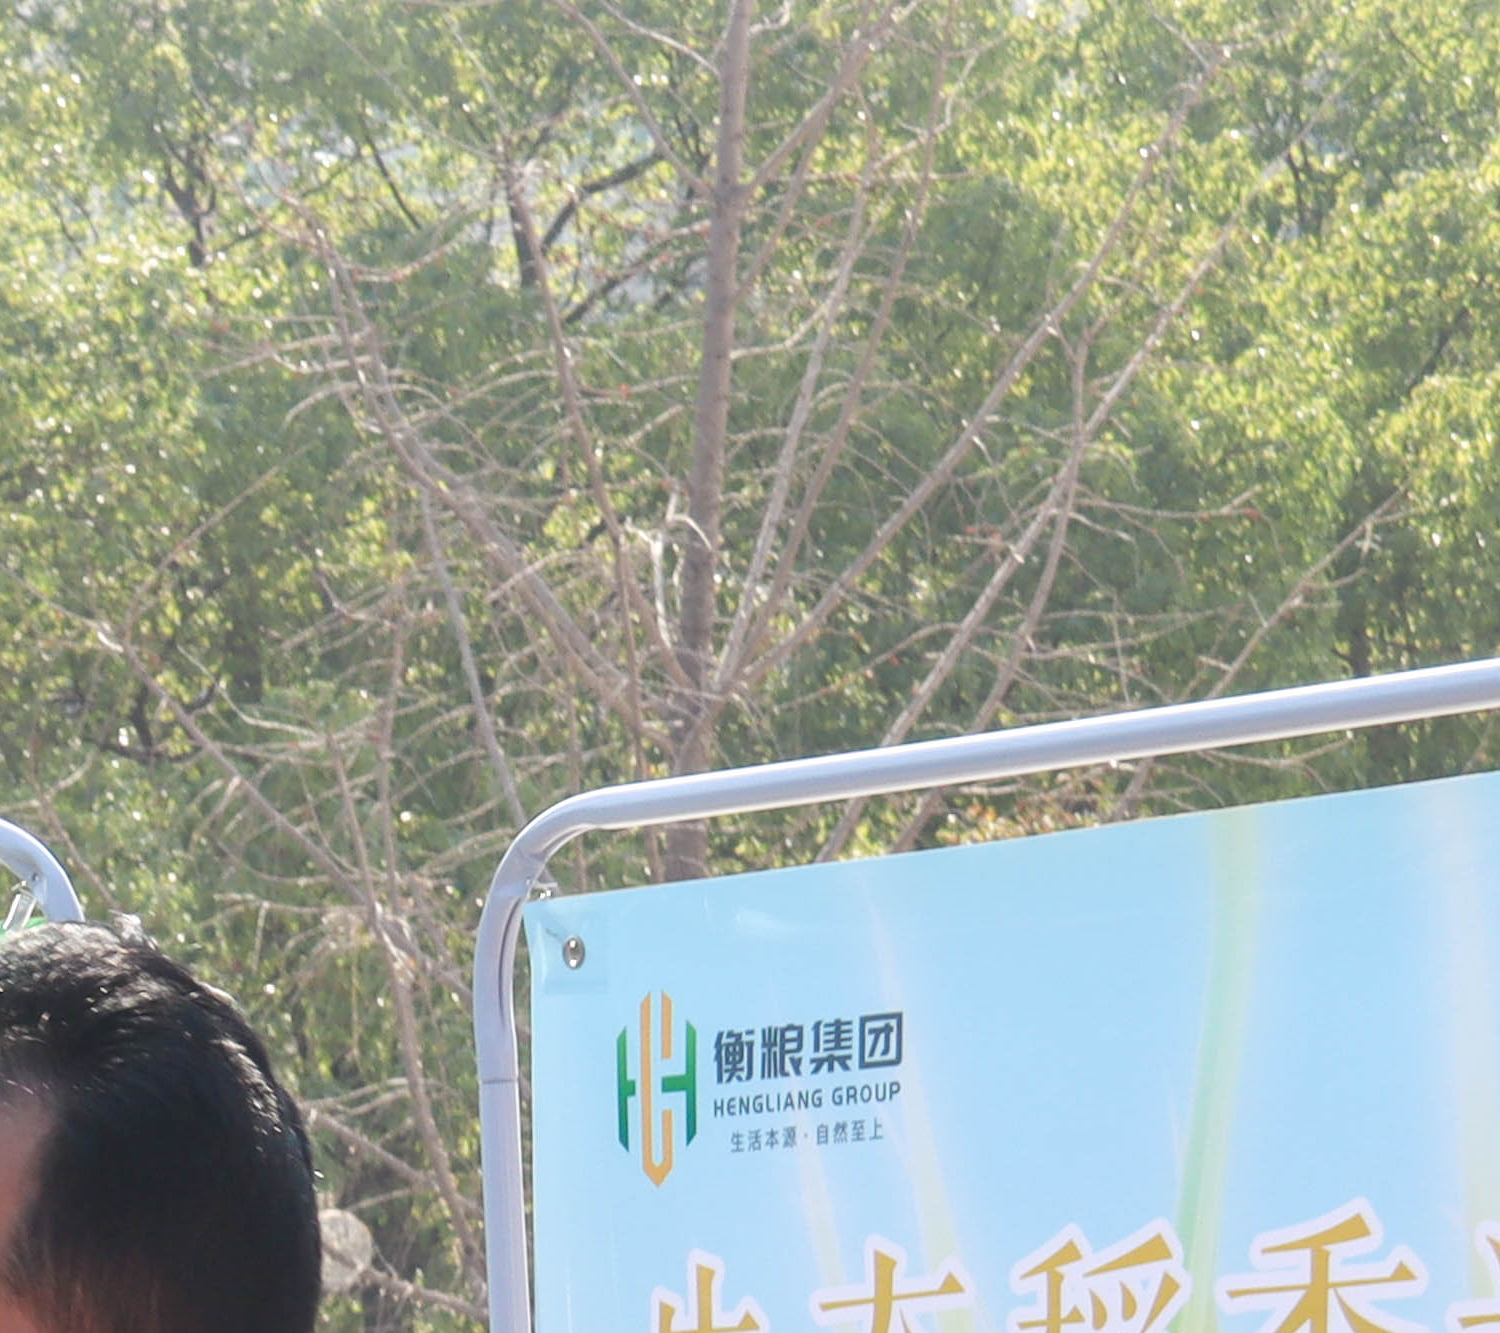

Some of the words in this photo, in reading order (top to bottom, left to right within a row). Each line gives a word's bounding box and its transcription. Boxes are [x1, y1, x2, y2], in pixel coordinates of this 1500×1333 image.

[713, 1011, 904, 1084] 衡粮集团
[714, 1088, 823, 1118] HENGLIANG
[832, 1080, 902, 1108] GROUP
